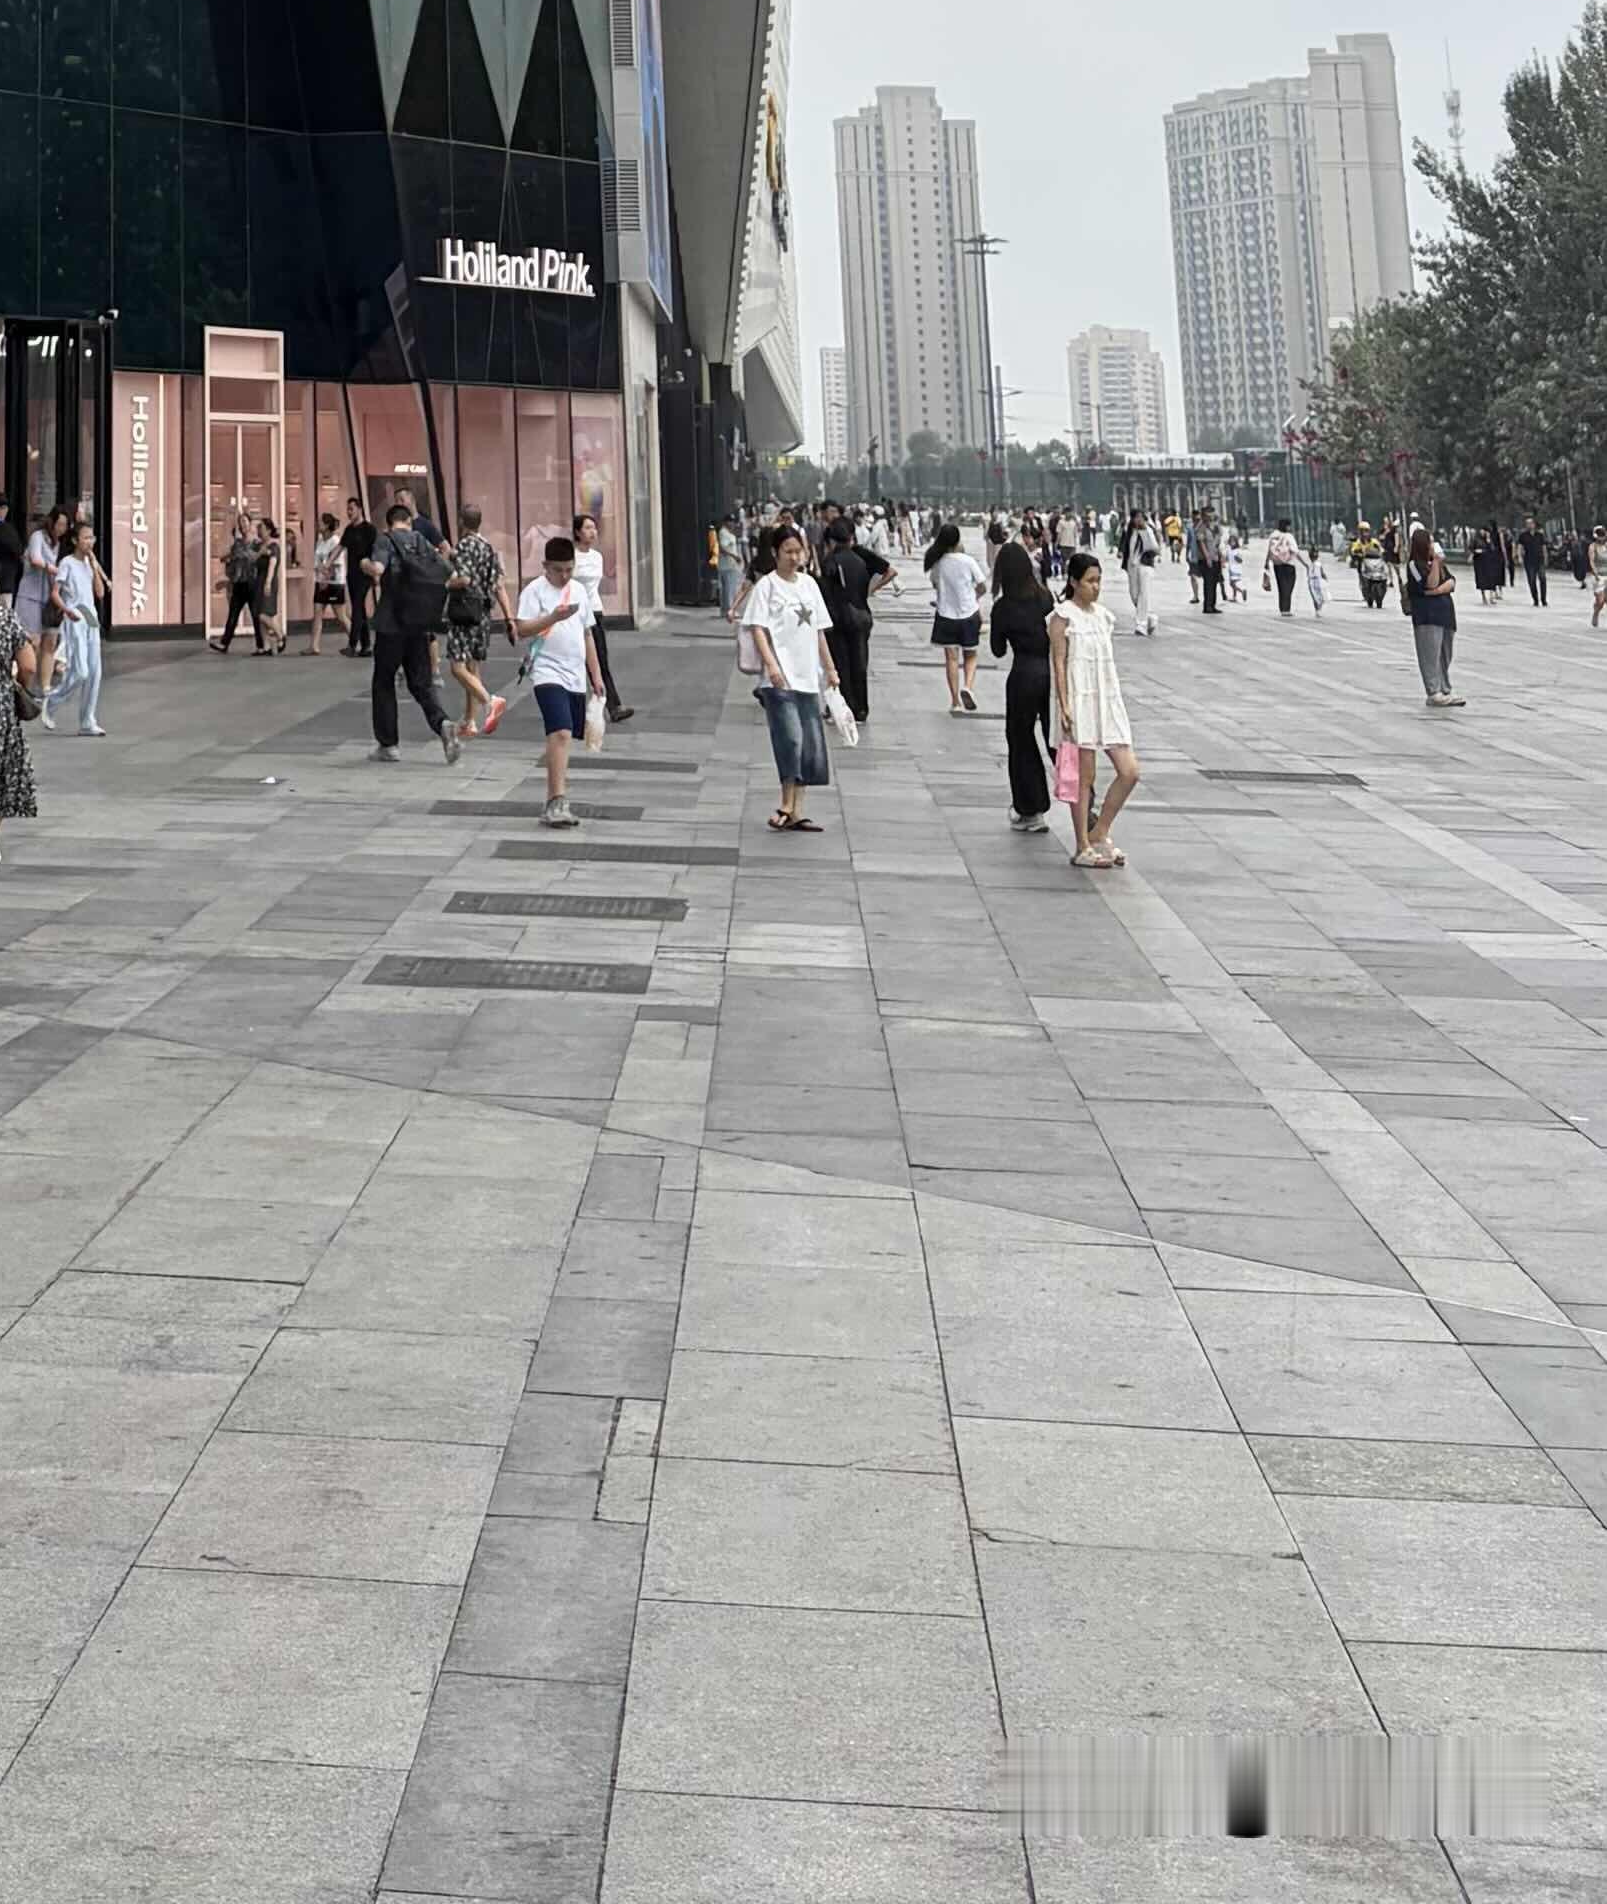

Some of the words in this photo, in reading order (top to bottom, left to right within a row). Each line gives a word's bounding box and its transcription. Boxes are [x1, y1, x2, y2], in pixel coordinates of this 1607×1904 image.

[444, 237, 540, 290] Holiland
[543, 247, 594, 295] Pink.
[132, 395, 150, 533] Holiland
[131, 538, 150, 618] Pink.
